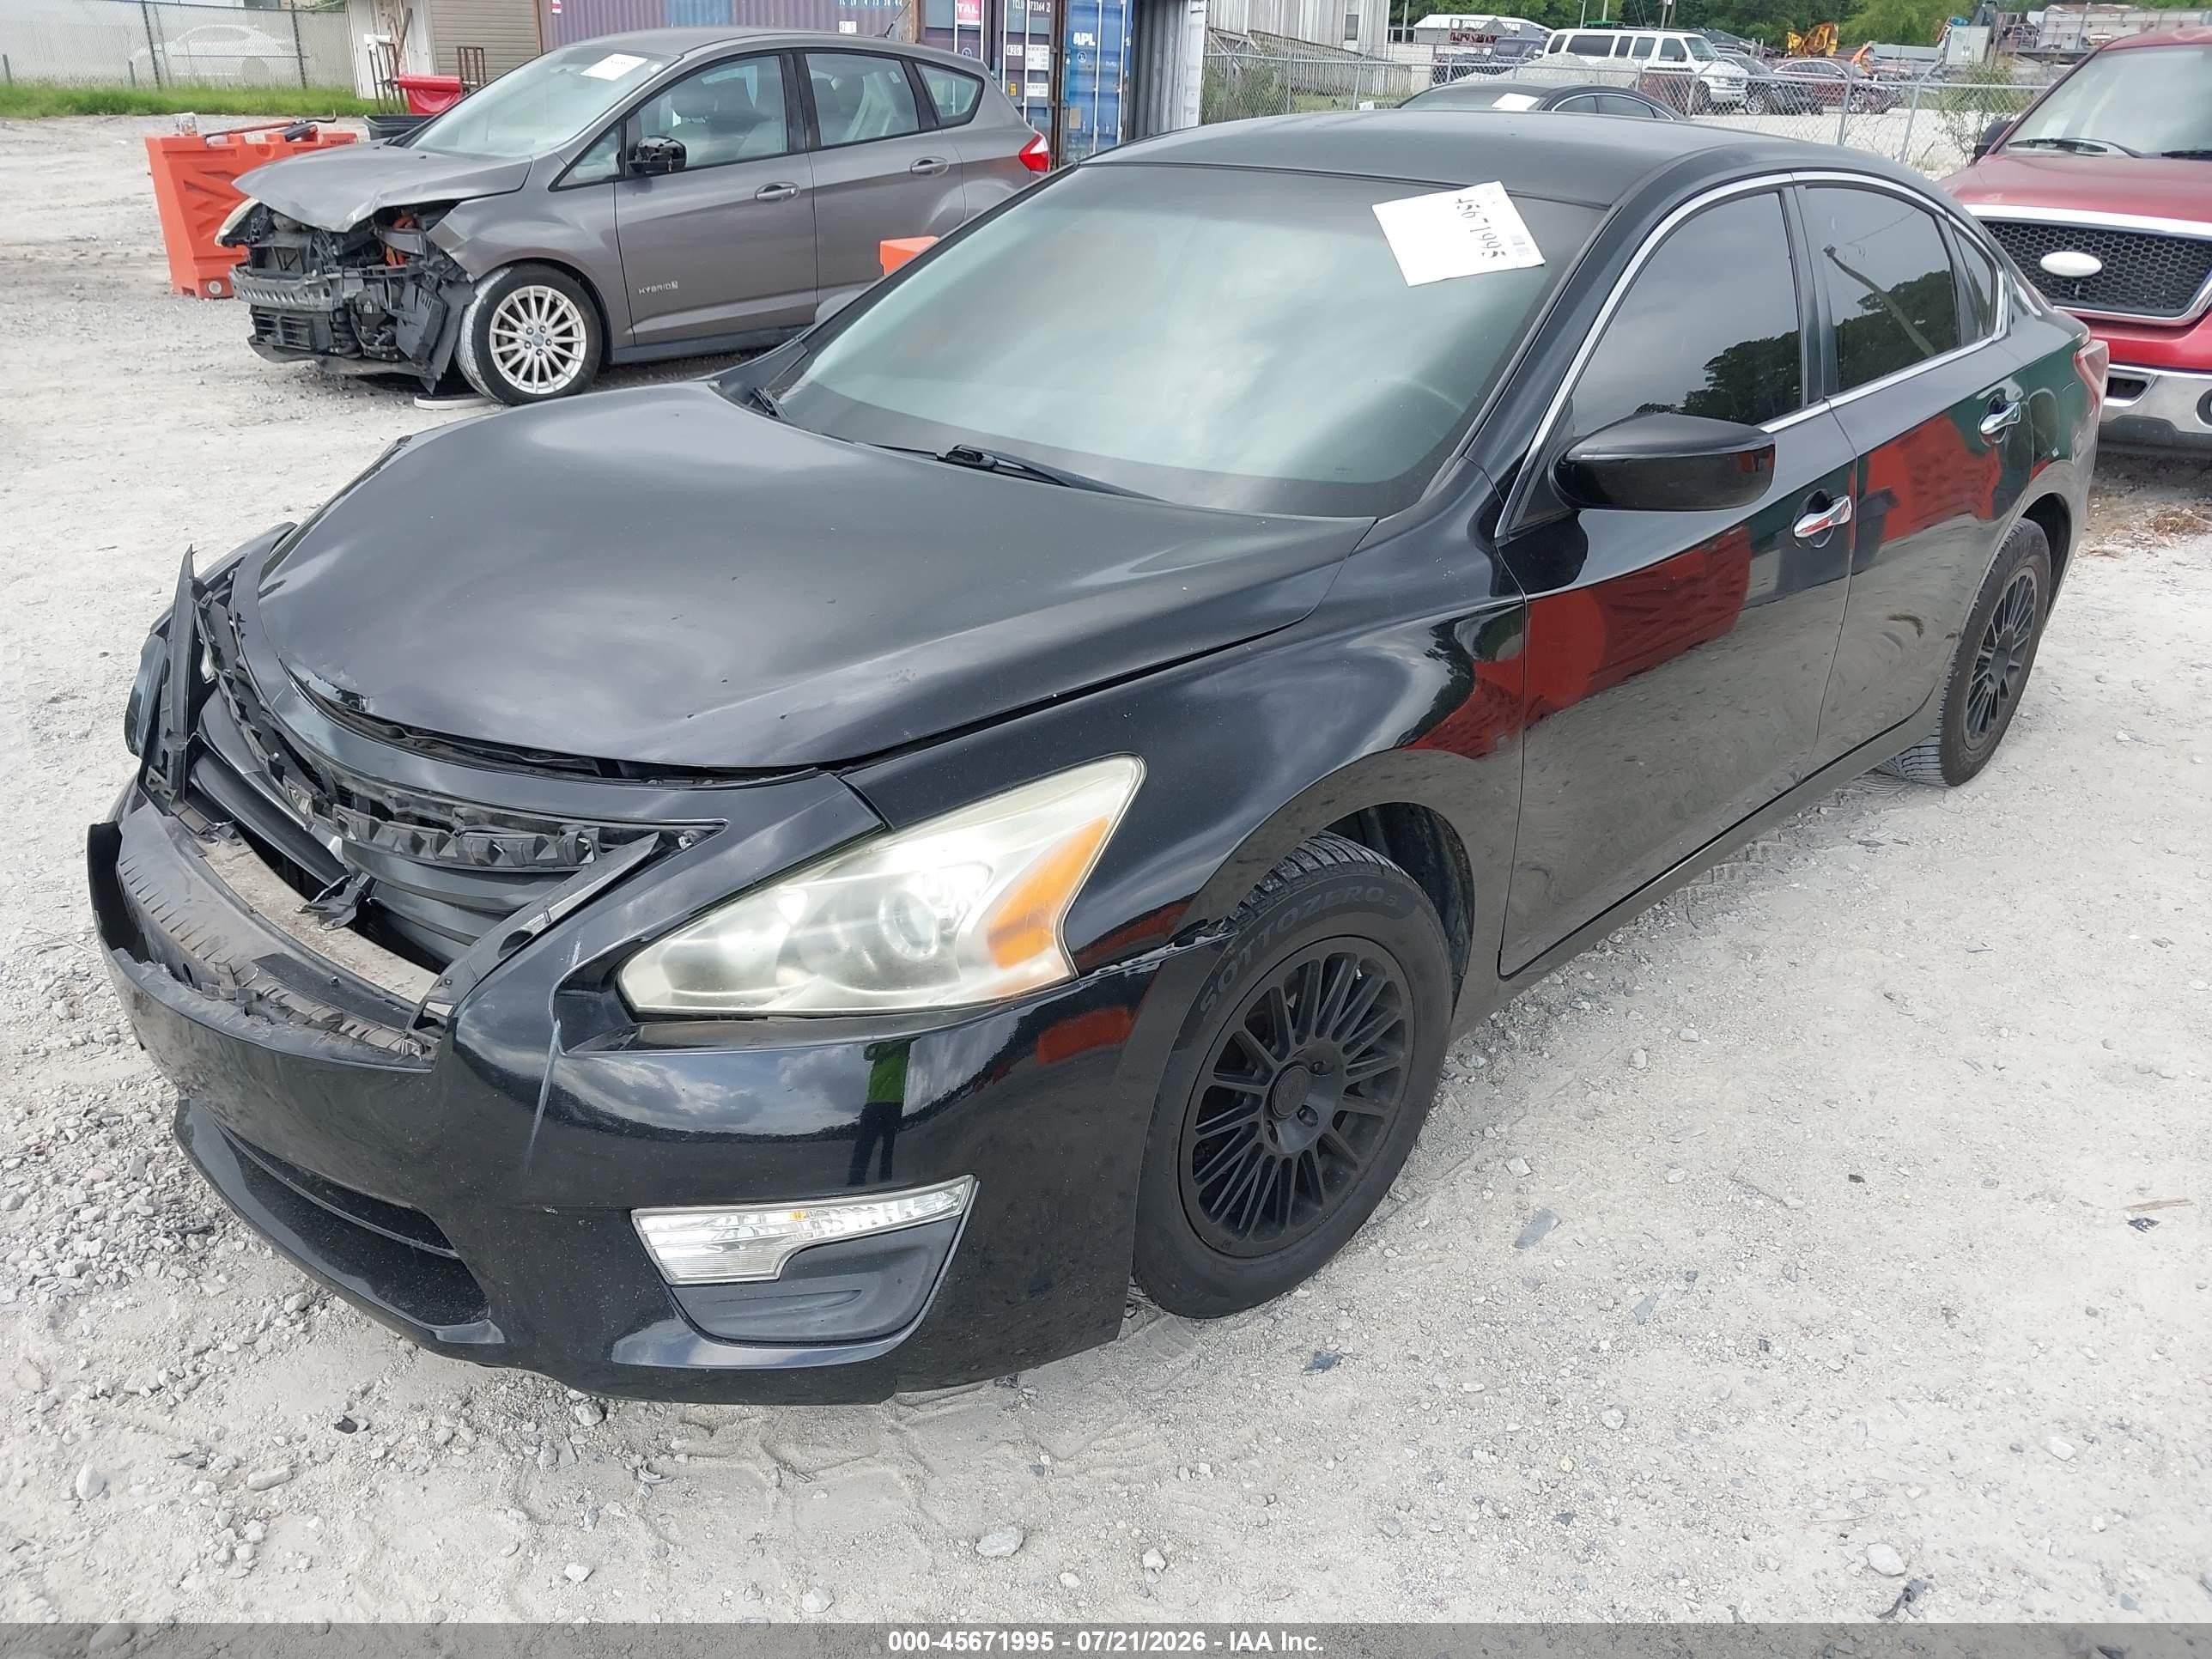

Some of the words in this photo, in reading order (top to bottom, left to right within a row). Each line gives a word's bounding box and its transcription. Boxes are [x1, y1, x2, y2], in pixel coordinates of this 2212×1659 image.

[957, 3, 979, 15] TAL
[1030, 1, 1045, 12] 73364
[1046, 2, 1051, 13] 2
[1073, 32, 1096, 46] APL
[638, 283, 672, 295] HYBRID
